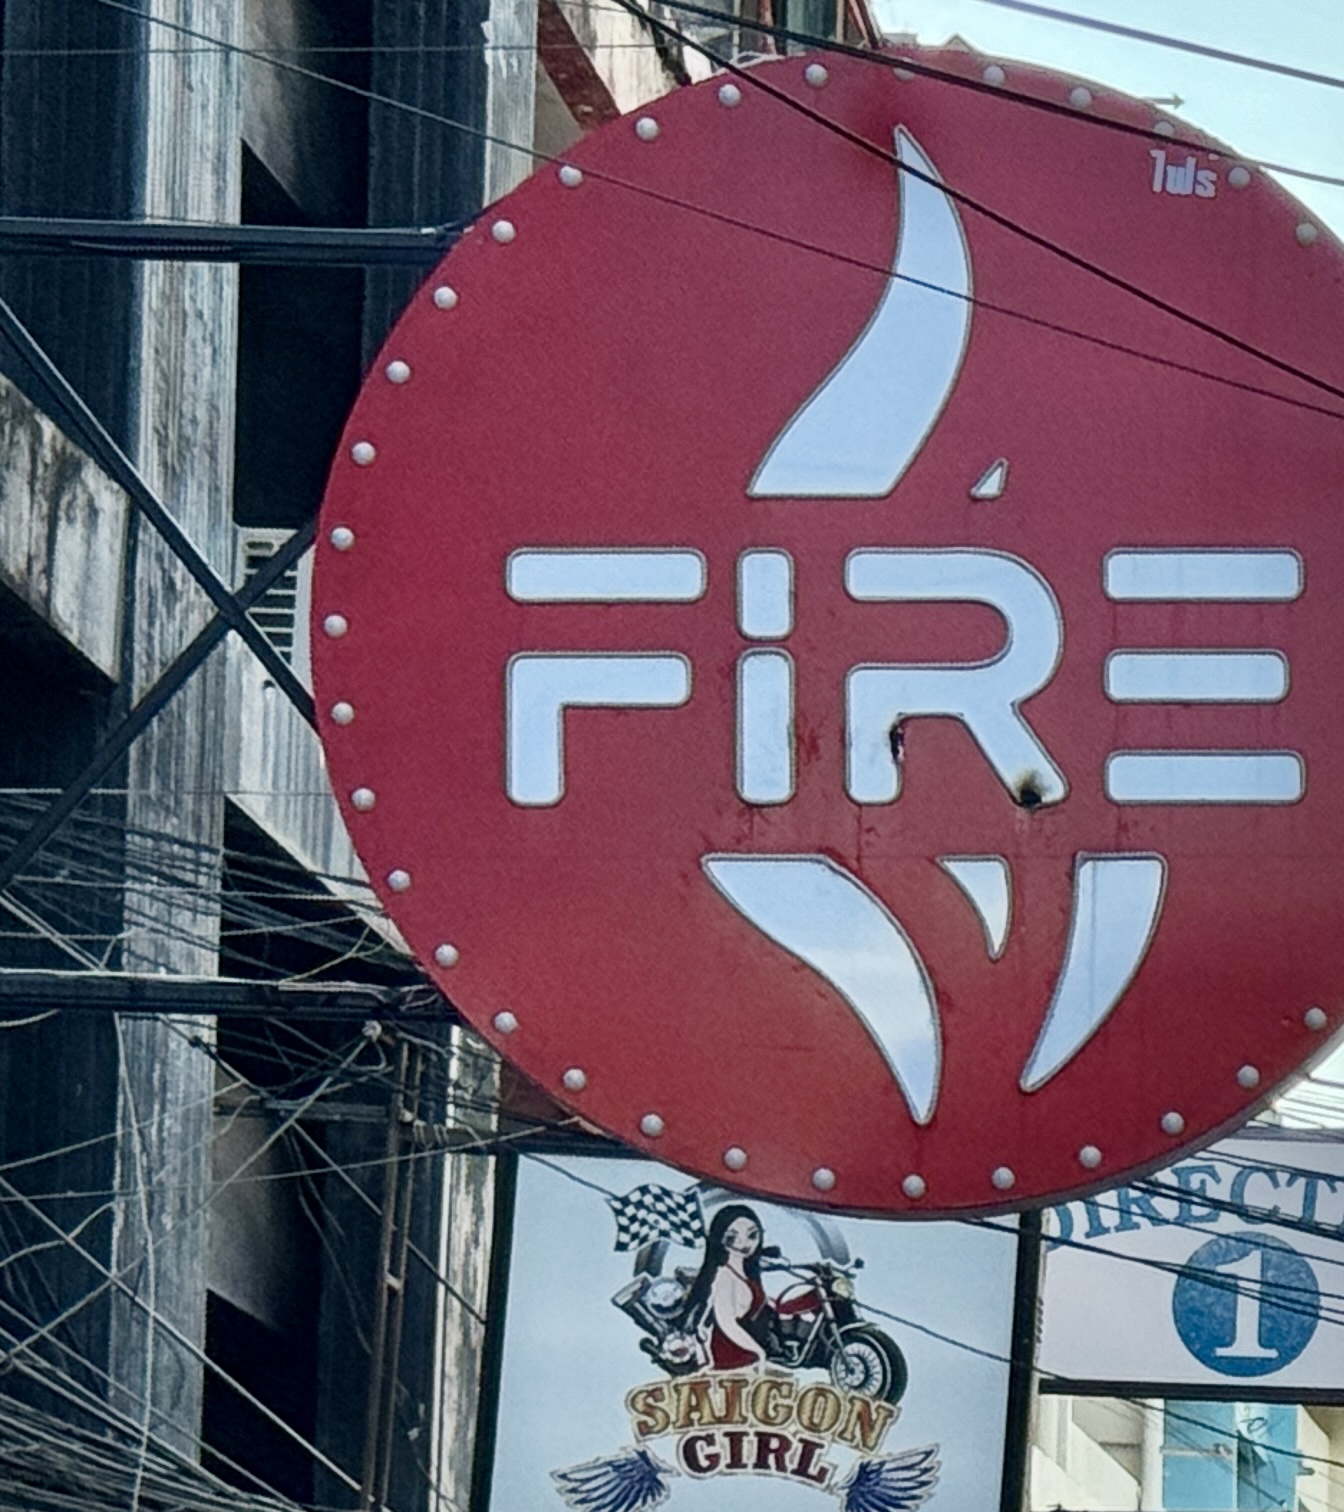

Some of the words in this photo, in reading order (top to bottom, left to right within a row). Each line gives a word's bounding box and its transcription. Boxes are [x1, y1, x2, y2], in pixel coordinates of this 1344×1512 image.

[506, 546, 1305, 805] FIRE
[1215, 1249, 1279, 1359] 1
[628, 1370, 898, 1452] SAIGON
[681, 1435, 836, 1485] GIRL
